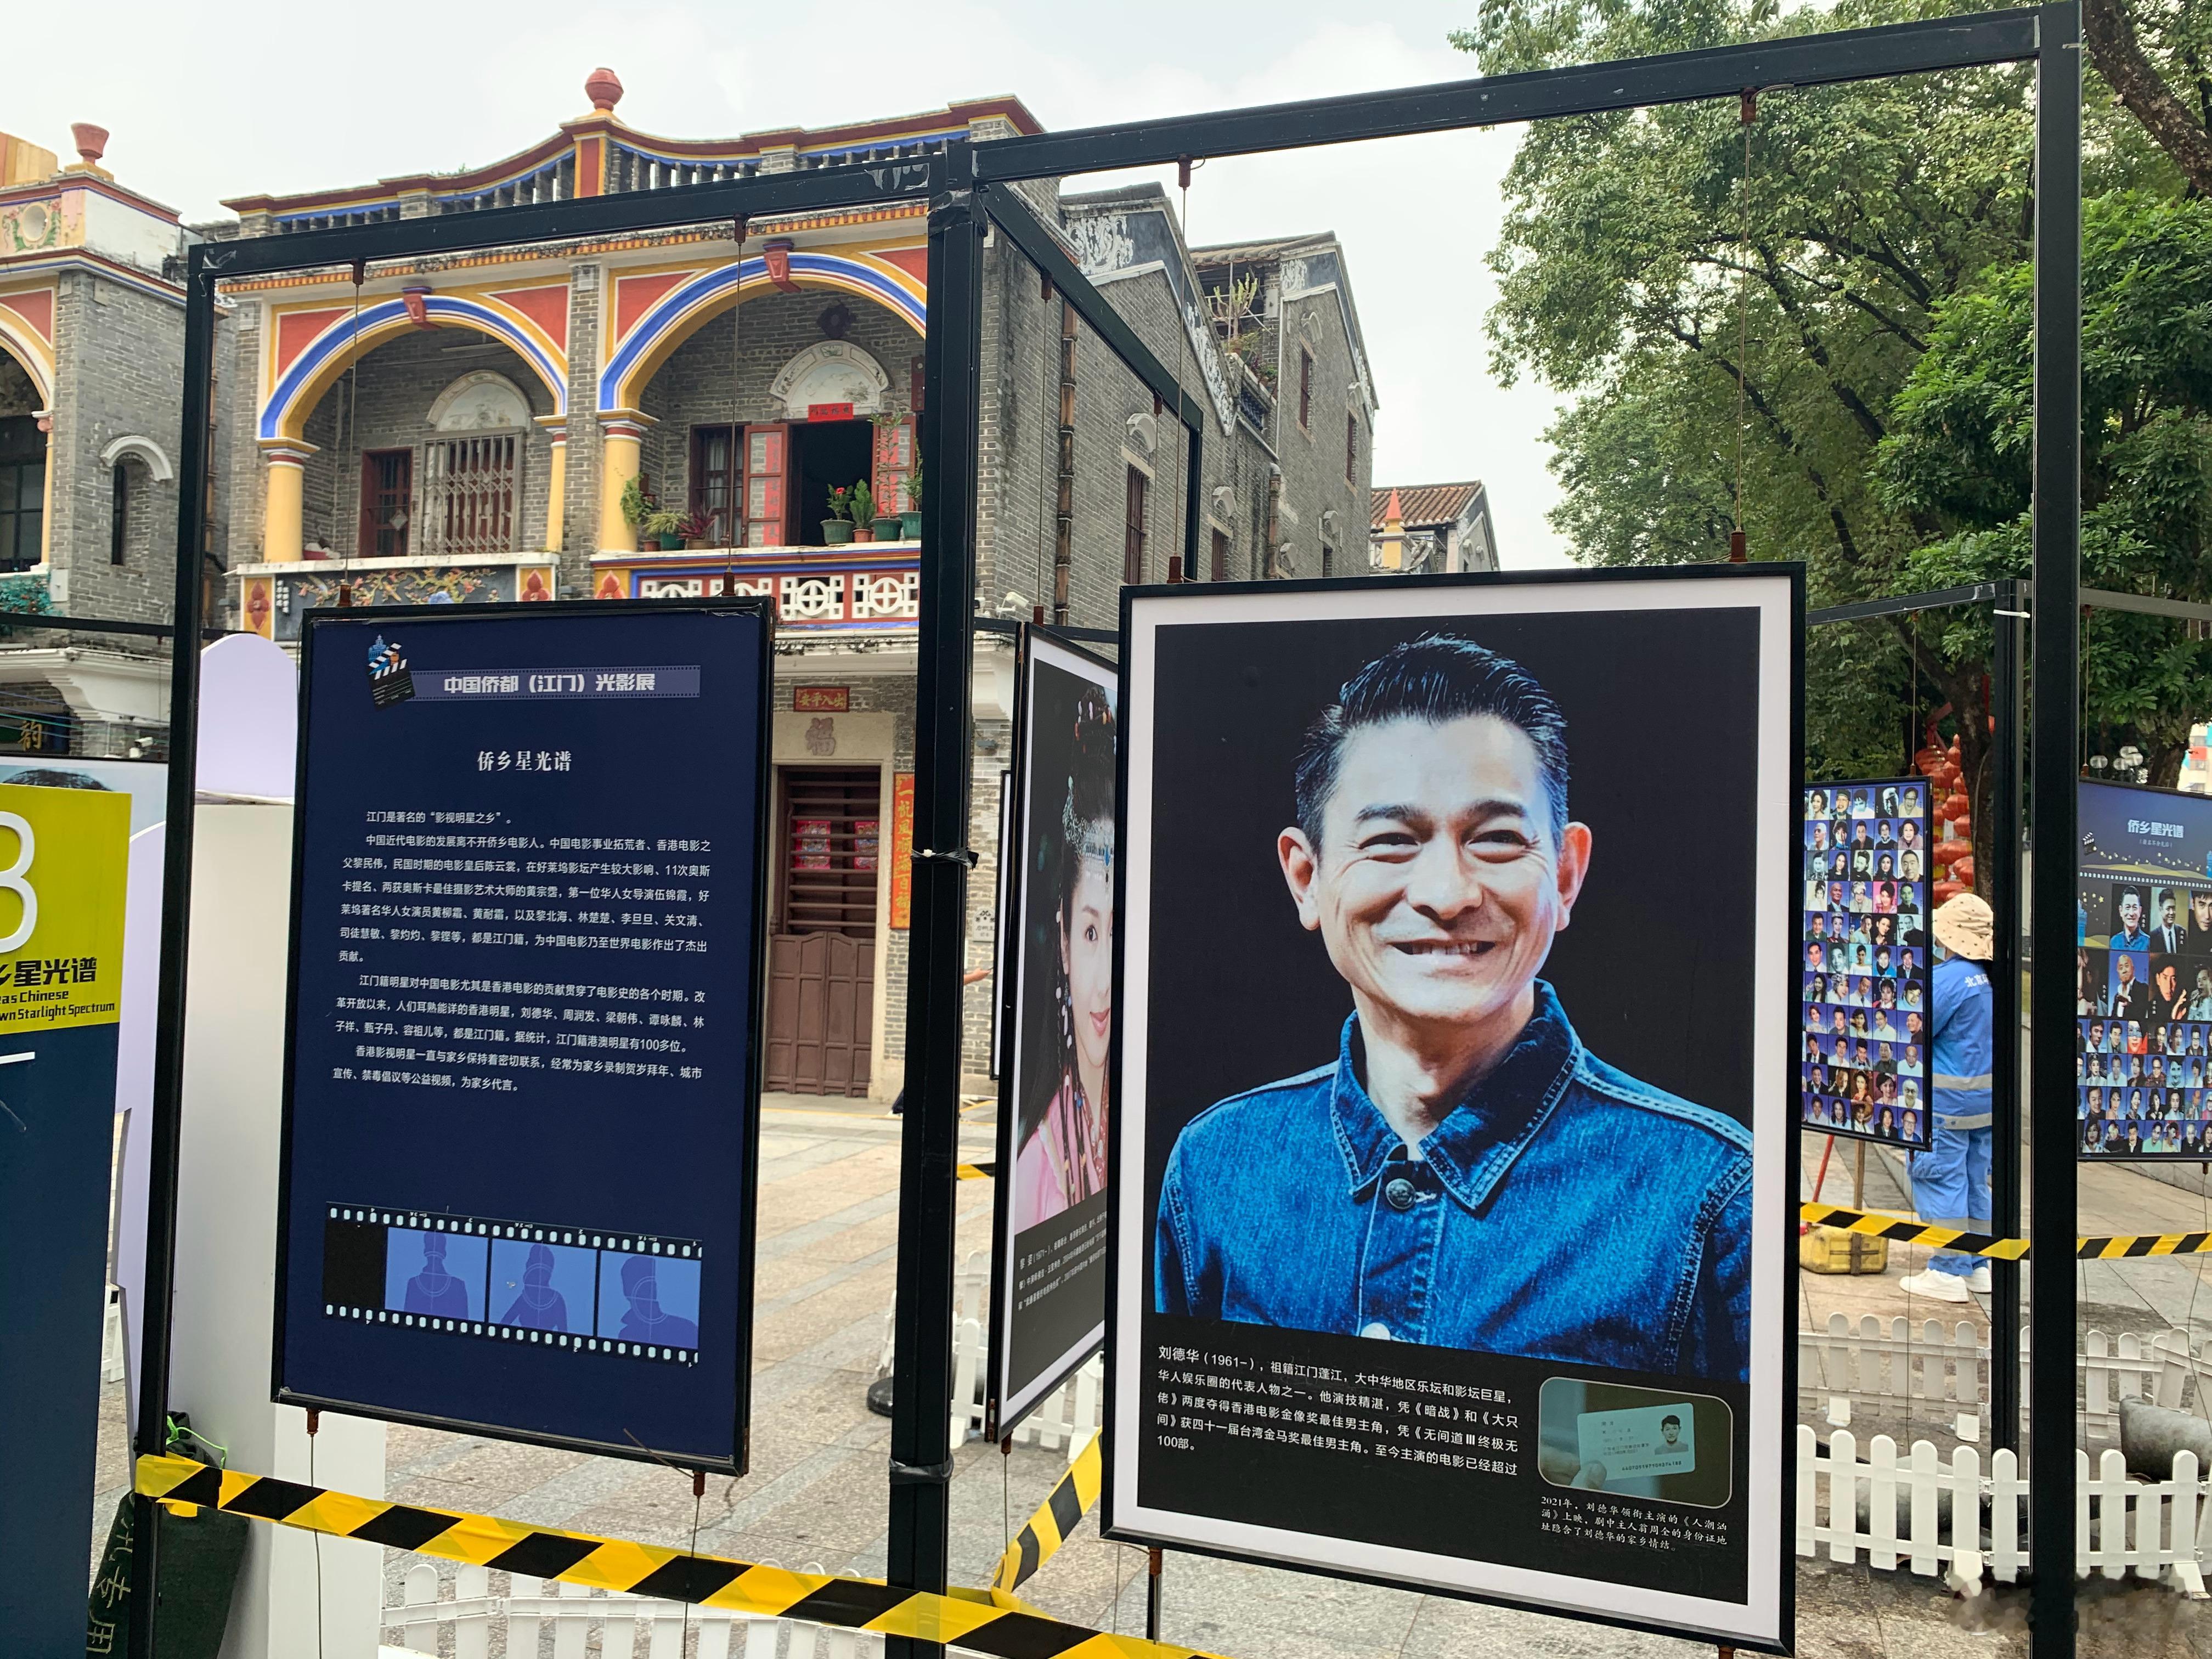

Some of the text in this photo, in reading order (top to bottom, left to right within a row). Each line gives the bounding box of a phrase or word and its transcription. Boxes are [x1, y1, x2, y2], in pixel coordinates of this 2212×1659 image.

[444, 673, 655, 693] 中国侨都（江门）光影展
[477, 751, 572, 771] 侨乡星光谱
[2128, 819, 2184, 838] 侨乡星光谱
[366, 834, 711, 852] 中国近代电影的发展离不开侨乡电影人。中国电影事业拓荒者、香港电影之
[338, 950, 364, 962] 贡献。
[0, 990, 69, 1005] as Chinese
[18, 1005, 66, 1022] Starlight
[69, 1002, 115, 1017] Spectrum
[332, 1068, 518, 1092] 宣传、禁毒倡议等公益视频，为家乡代言。
[1158, 1369, 1519, 1428] 华人娱乐圈的代表人物之一。他演技精湛，凭《暗战》和《大只
[1156, 1413, 1518, 1476] 间》获四十一届台湾金马奖最佳男主角。至今主演的电影已经超过
[1157, 1435, 1195, 1451] 100部。
[1541, 1522, 1676, 1551] 址隐含了刘德华的家乡情结。
